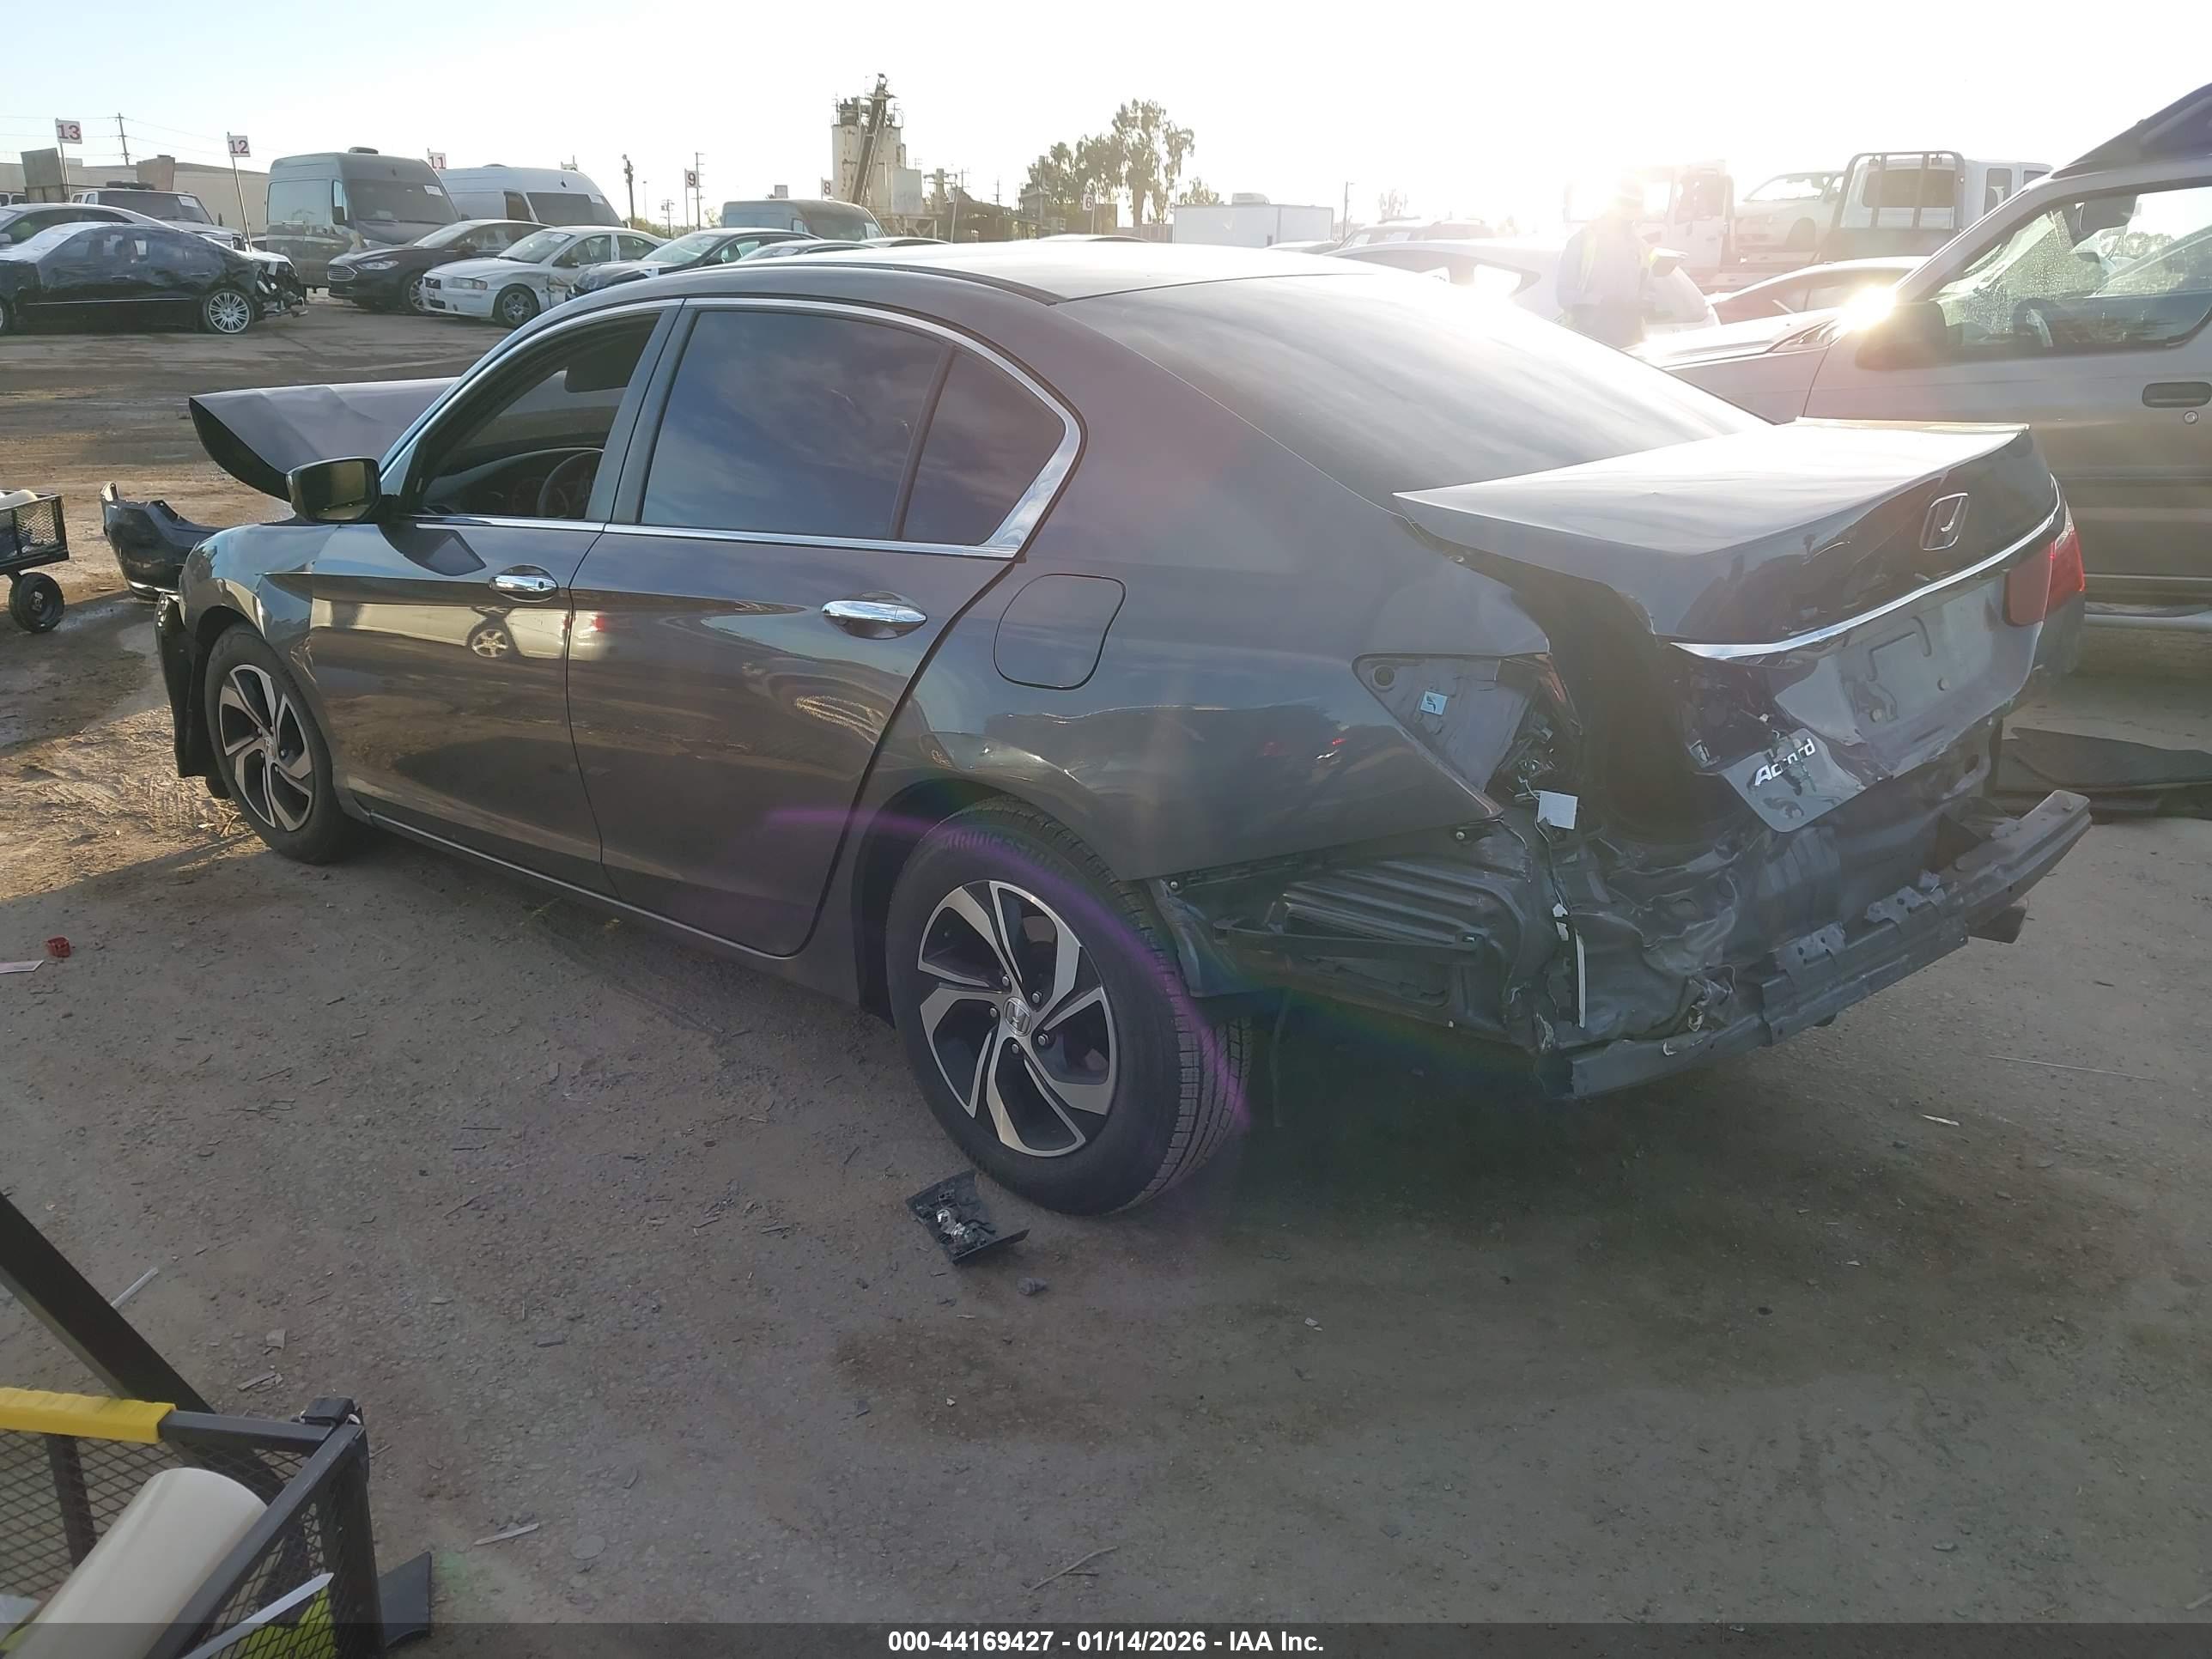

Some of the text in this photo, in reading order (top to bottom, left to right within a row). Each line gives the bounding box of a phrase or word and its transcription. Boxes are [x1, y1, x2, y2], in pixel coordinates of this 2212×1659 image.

[57, 124, 80, 140] 13
[228, 139, 249, 154] 12
[428, 155, 447, 169] 11
[687, 172, 696, 186] 9
[823, 181, 831, 195] 8
[1754, 738, 1816, 787] Acord
